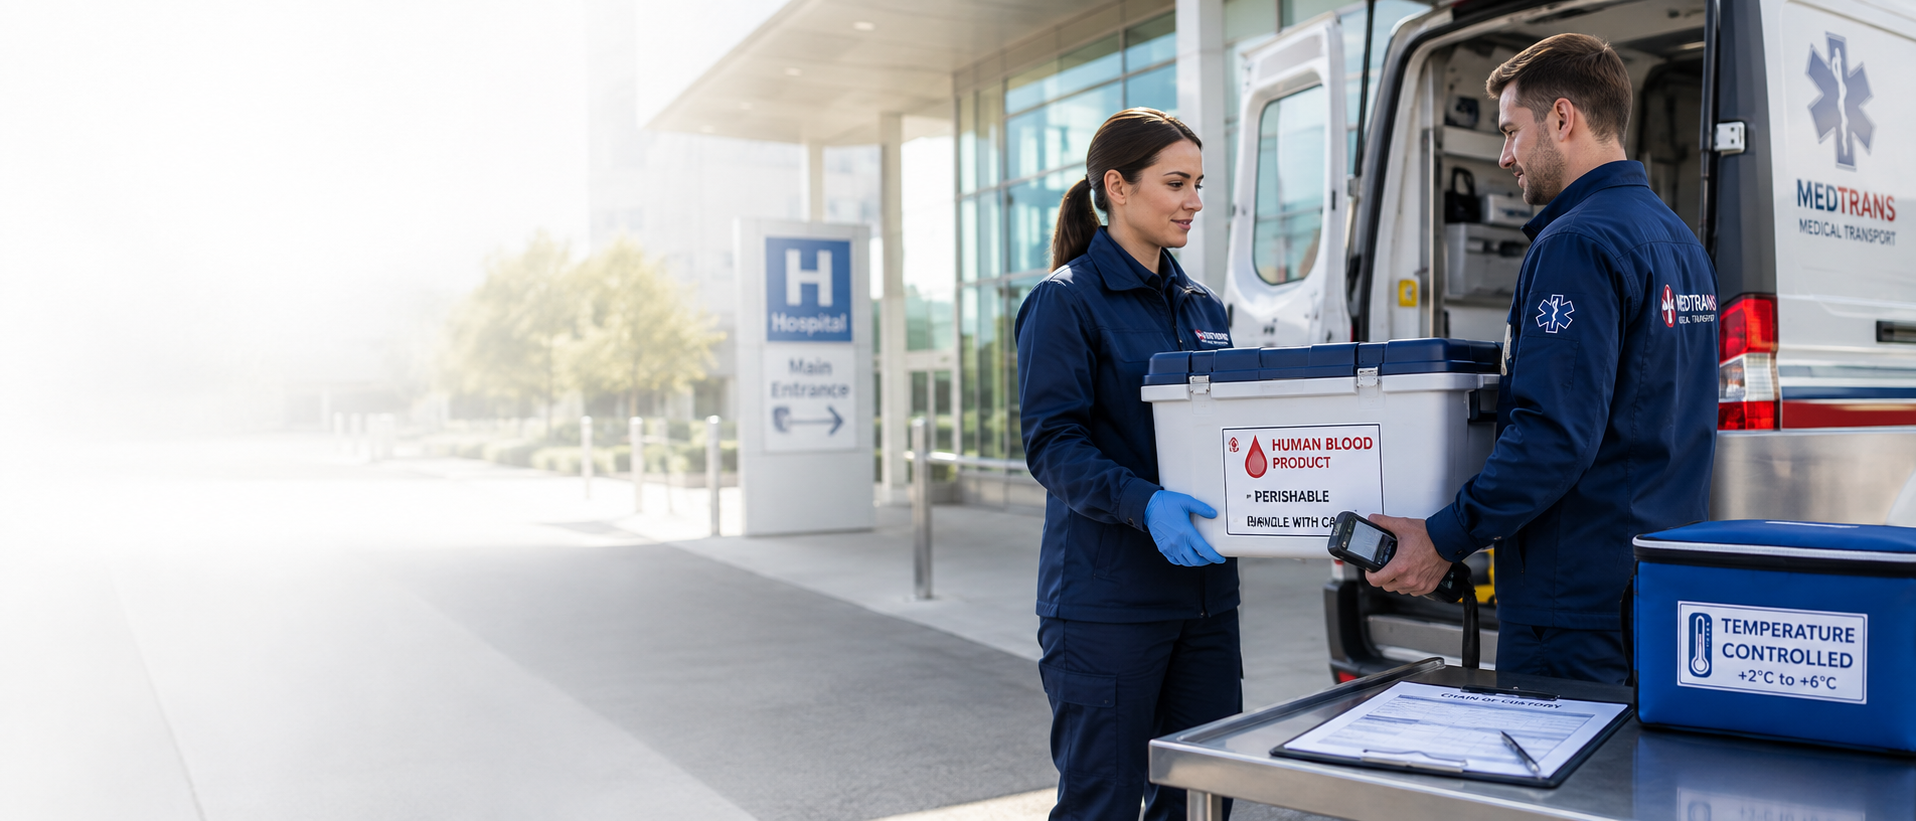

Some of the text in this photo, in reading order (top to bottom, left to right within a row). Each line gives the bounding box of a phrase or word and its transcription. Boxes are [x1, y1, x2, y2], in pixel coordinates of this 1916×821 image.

[1797, 178, 1896, 222] MEDTRANS
[1799, 218, 1896, 246] MEDICAL TRANSPORT
[786, 248, 833, 307] H
[771, 312, 848, 337] Hospital
[788, 358, 833, 376] Main
[771, 382, 850, 399] Entrance
[1272, 437, 1373, 451] HUMAN BLOOD
[1273, 456, 1331, 469] PRODUCT
[1254, 490, 1329, 502] PERISHABLE
[1292, 516, 1319, 528] WITH
[1721, 617, 1855, 643] TEMPERATURE
[1722, 642, 1853, 669] CONTROLLED
[1738, 669, 1837, 690] +2°C to +6°C
